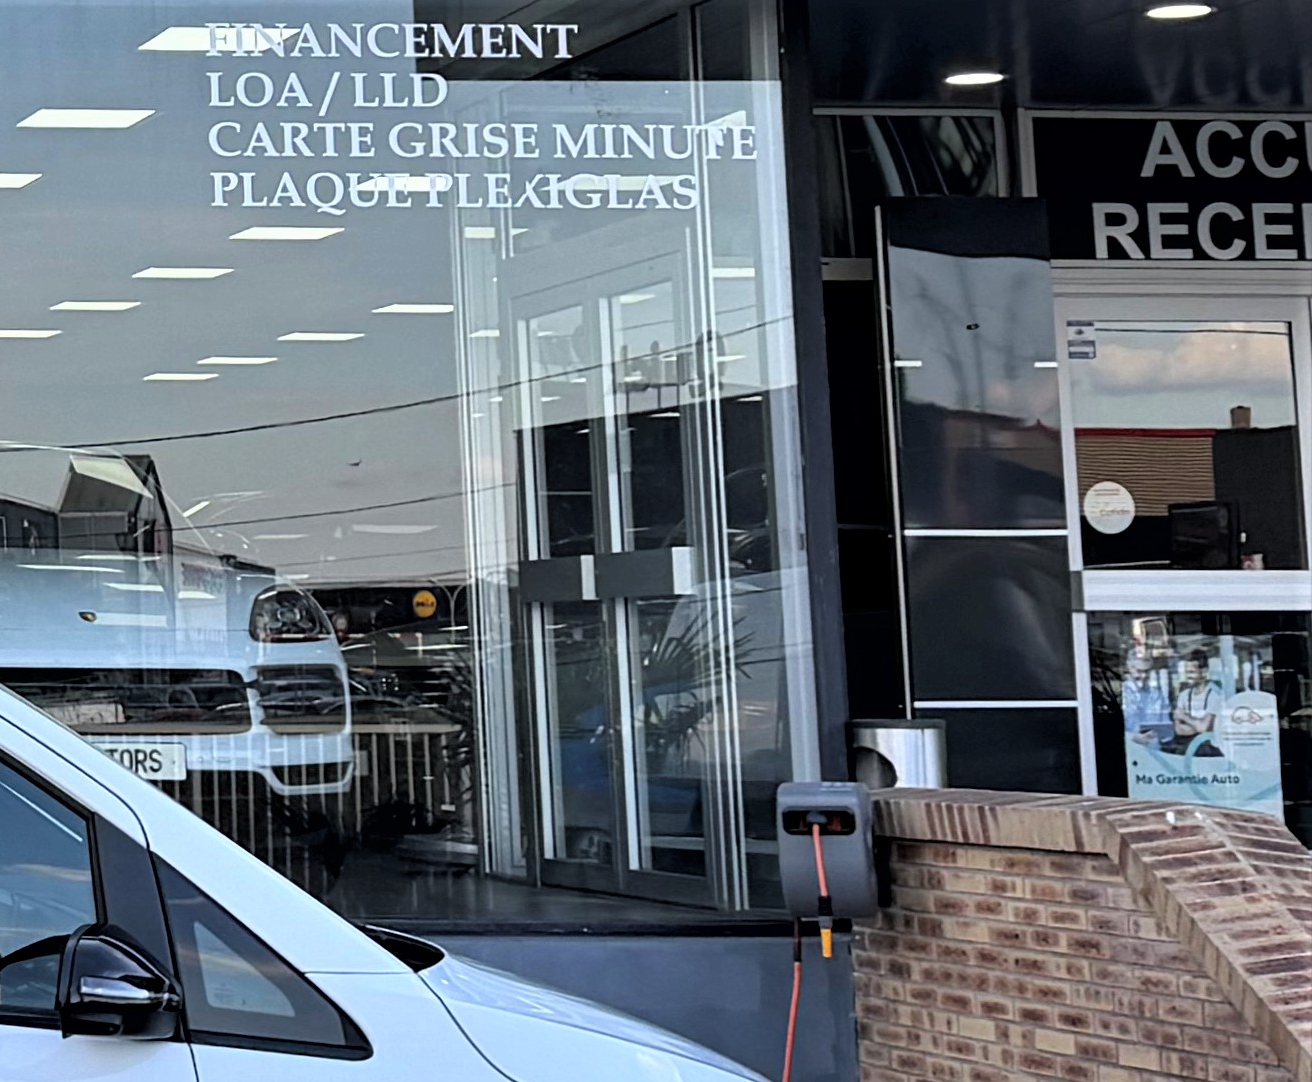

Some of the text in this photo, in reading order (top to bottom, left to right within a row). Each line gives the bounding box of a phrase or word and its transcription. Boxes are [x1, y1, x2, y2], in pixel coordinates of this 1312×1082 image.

[205, 22, 579, 59] FINANCEMENT
[206, 71, 313, 108] LOA
[352, 71, 449, 108] LLD
[208, 121, 758, 161] CARTE GRISE MINUTE
[211, 172, 700, 215] PLAQUE PLEXIGLAS
[1091, 201, 1312, 260] RECE
[1135, 773, 1240, 785] Ma Garantie Auto
